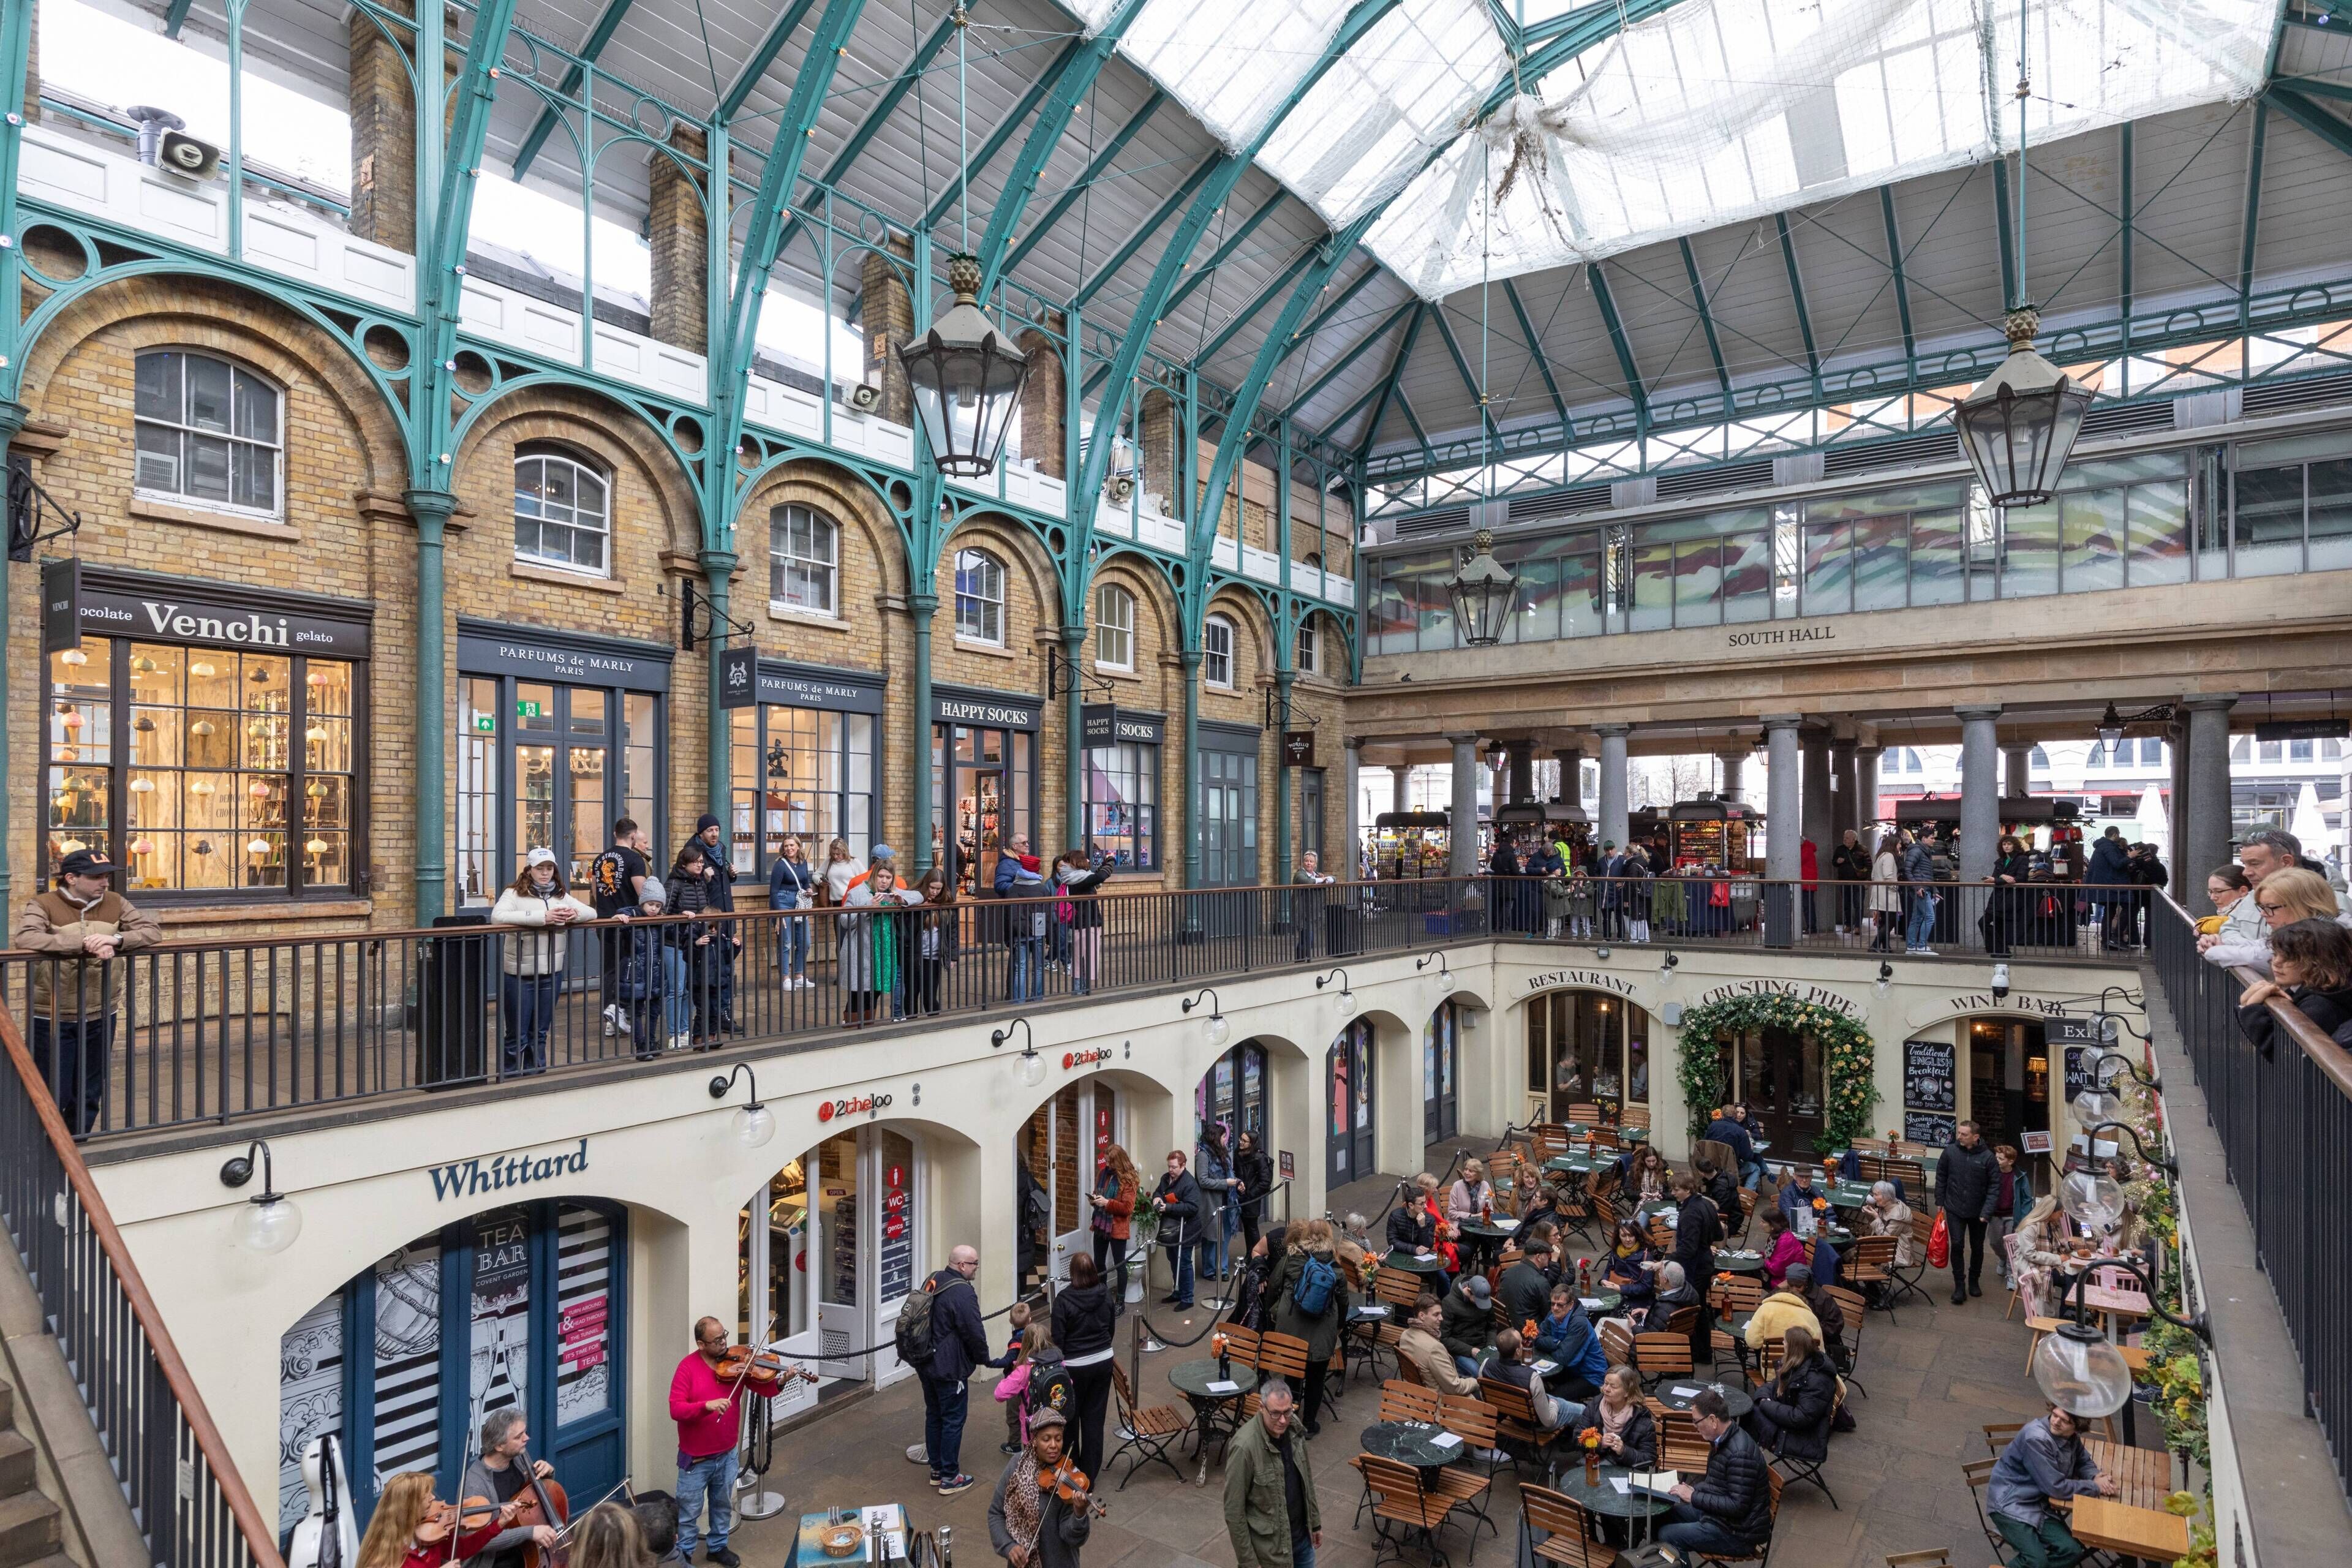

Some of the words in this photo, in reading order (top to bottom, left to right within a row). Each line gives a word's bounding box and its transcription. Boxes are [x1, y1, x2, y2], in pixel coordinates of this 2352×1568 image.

[53, 600, 69, 612] VENCHI
[80, 607, 132, 620] ocolate
[141, 602, 290, 646] Venchi
[296, 631, 333, 643] gelato
[1729, 630, 1784, 647] SOUTH
[1789, 627, 1836, 642] HALL
[499, 647, 565, 663] PARFUMS
[571, 656, 584, 666] de
[590, 658, 633, 672] MARLY
[555, 665, 584, 676] PARIS
[761, 679, 808, 692] PARFUMS
[826, 687, 857, 698] MARLY
[941, 703, 986, 720] HAPPY
[987, 707, 1028, 725] SOCKS
[1087, 718, 1109, 726] HAPPY
[1121, 724, 1153, 738] SOCKS
[90, 853, 110, 864] LA
[1528, 971, 1637, 995] RESTAURANT
[1703, 980, 1798, 1006] CRUSTING
[1808, 986, 1857, 1017] PIPE
[1951, 994, 2005, 1011] WINE
[2018, 995, 2062, 1016] BAR
[2064, 1025, 2098, 1038] Exit
[1074, 1047, 1112, 1066] 2theloo
[1906, 1042, 1951, 1058] Traditional
[1911, 1056, 1953, 1068] ENGLISH
[1909, 1066, 1950, 1077] Breakfast
[2065, 1071, 2088, 1084] WAIT
[835, 1093, 892, 1117] 2theloo
[1906, 1114, 1932, 1125] Sharing
[1932, 1115, 1955, 1128] Boards
[1098, 1135, 1108, 1144] WC
[428, 1138, 589, 1202] Whittard
[889, 1196, 903, 1207] WC
[888, 1223, 903, 1233] gents
[479, 1224, 524, 1248] TEA
[478, 1245, 527, 1272] BAR
[476, 1276, 501, 1287] COVENT
[503, 1268, 528, 1280] GARDEN
[582, 1302, 601, 1311] AROUND
[563, 1316, 574, 1330] &
[586, 1311, 608, 1321] THROUGH
[581, 1328, 599, 1337] TUNNEL
[582, 1355, 598, 1366] TEA!
[1404, 1421, 1431, 1430] 219
